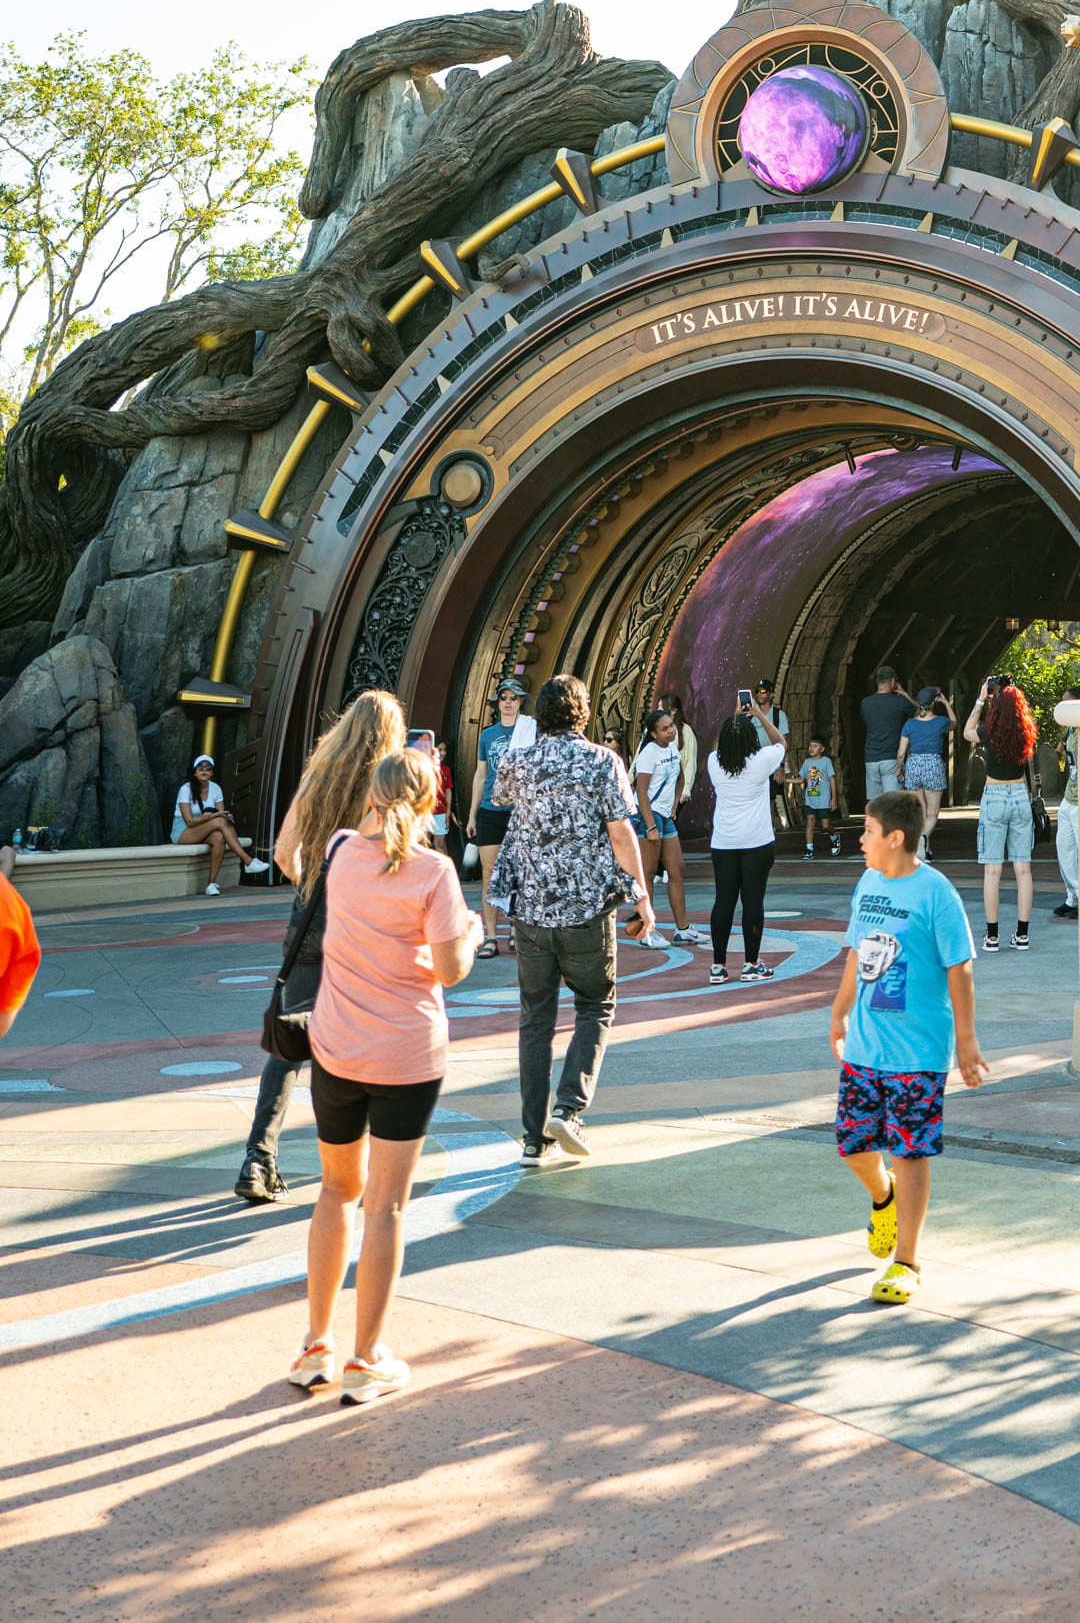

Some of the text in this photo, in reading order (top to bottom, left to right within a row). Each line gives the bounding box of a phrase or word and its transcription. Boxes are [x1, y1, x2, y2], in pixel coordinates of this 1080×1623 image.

[651, 293, 930, 345] IT'S ALIVE! IT'S ALIVE!
[859, 903, 910, 919] FURIOUS
